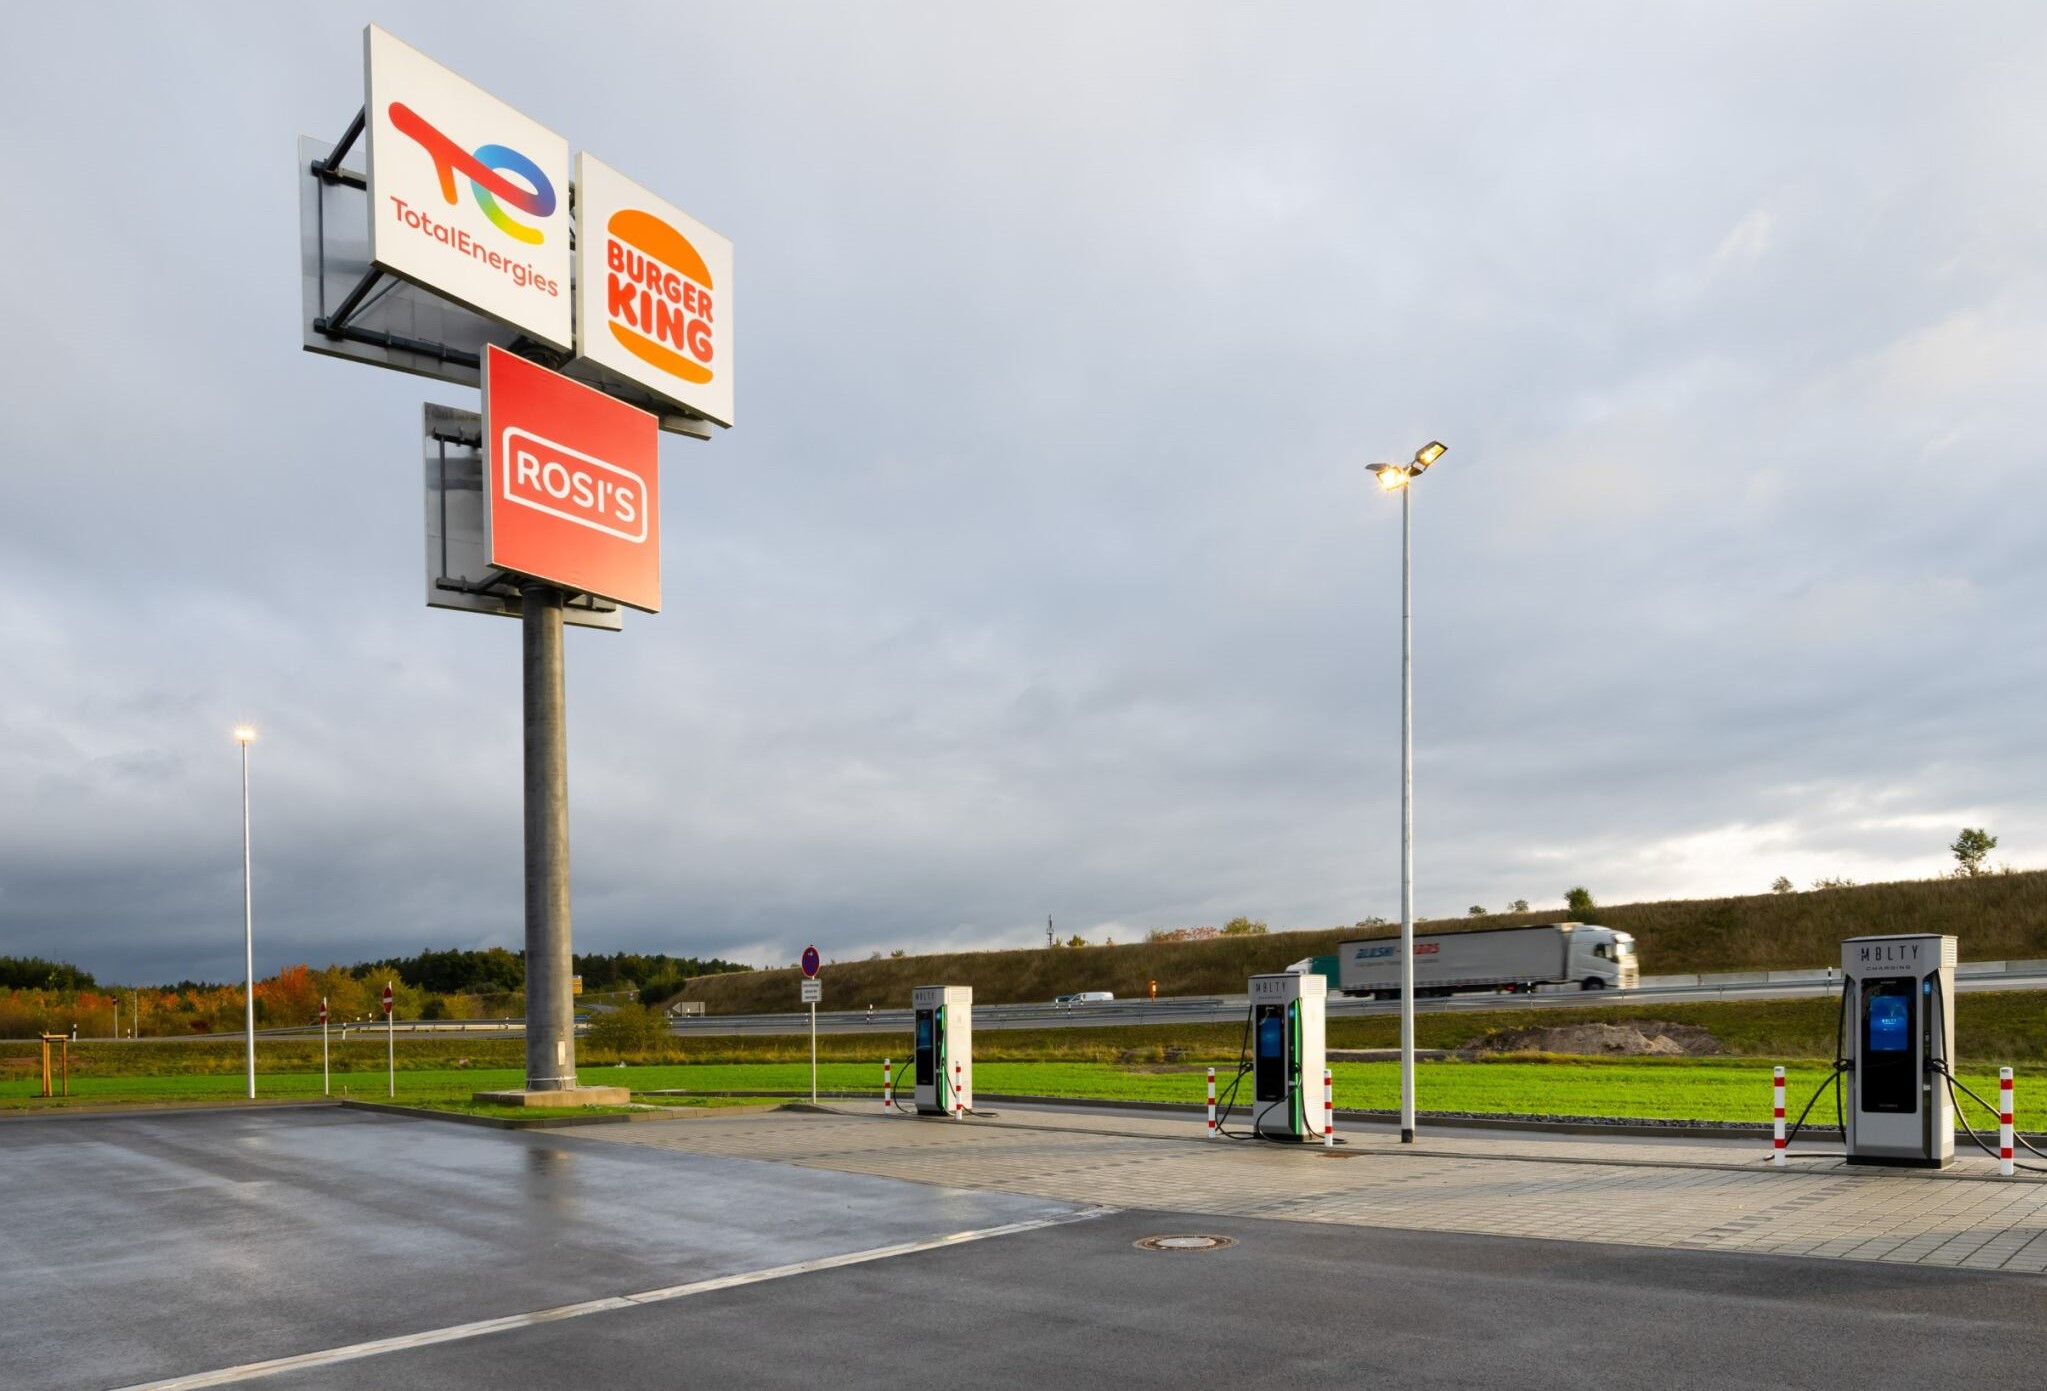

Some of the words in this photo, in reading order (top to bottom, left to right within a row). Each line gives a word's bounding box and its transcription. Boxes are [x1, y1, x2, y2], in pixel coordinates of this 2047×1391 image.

[390, 195, 559, 298] TotalEnergies
[607, 238, 714, 323] BURGER
[607, 272, 714, 363] KING
[517, 450, 636, 523] ROSI'S
[1861, 945, 1919, 961] MBLTY
